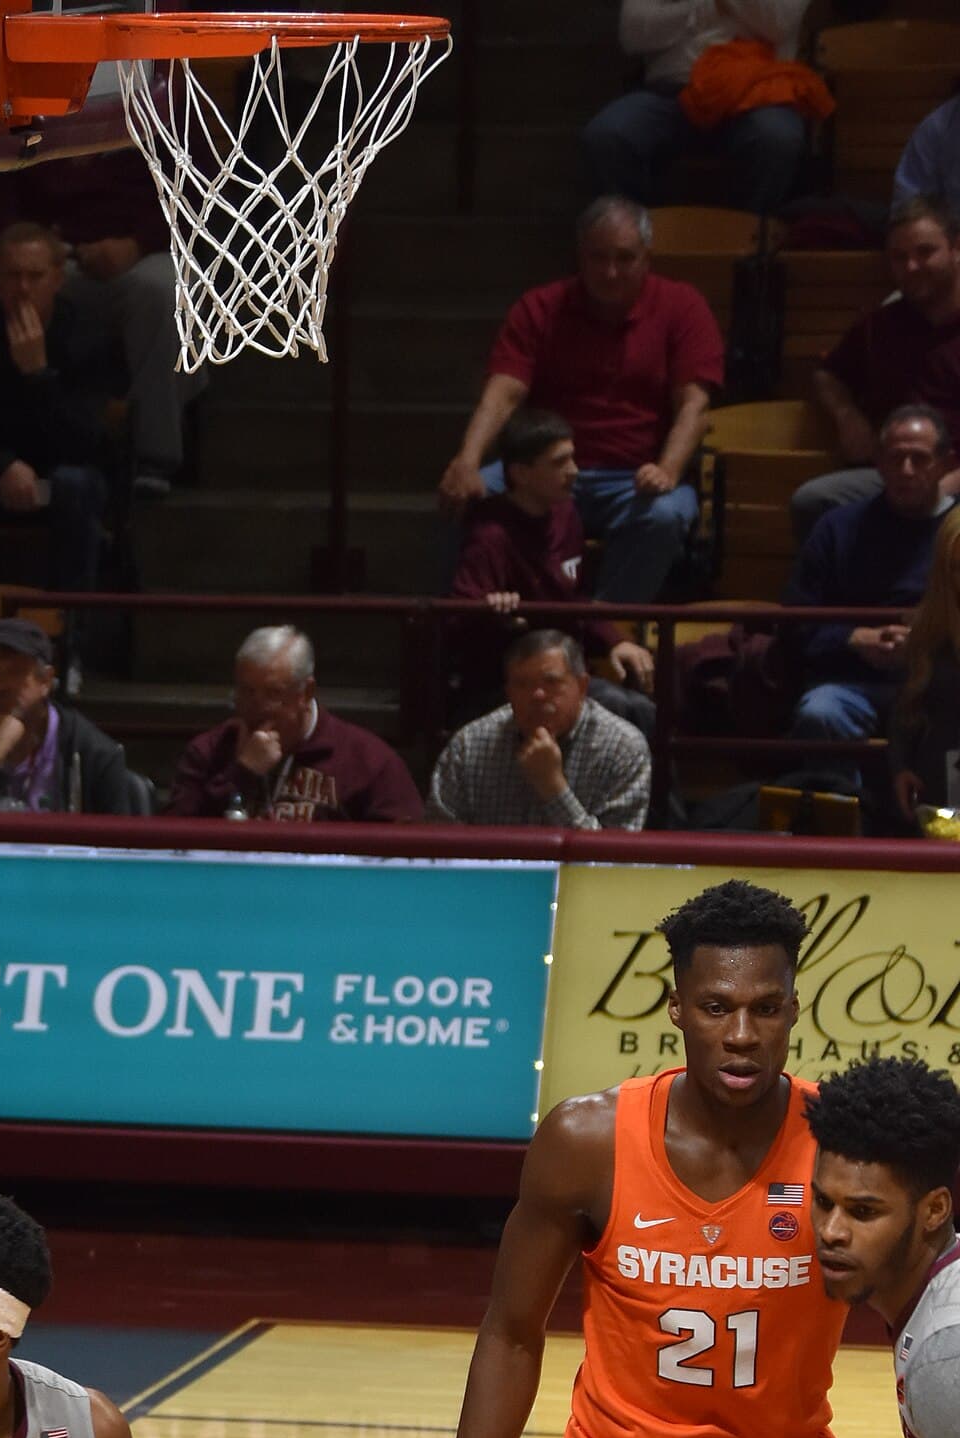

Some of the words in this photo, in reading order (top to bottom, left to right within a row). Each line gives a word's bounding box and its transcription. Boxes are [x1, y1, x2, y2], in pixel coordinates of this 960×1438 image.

[93, 964, 305, 1041] ONE
[334, 973, 493, 1008] FLOOR
[617, 1244, 813, 1289] SYRACUSE
[658, 1308, 760, 1388] 21
